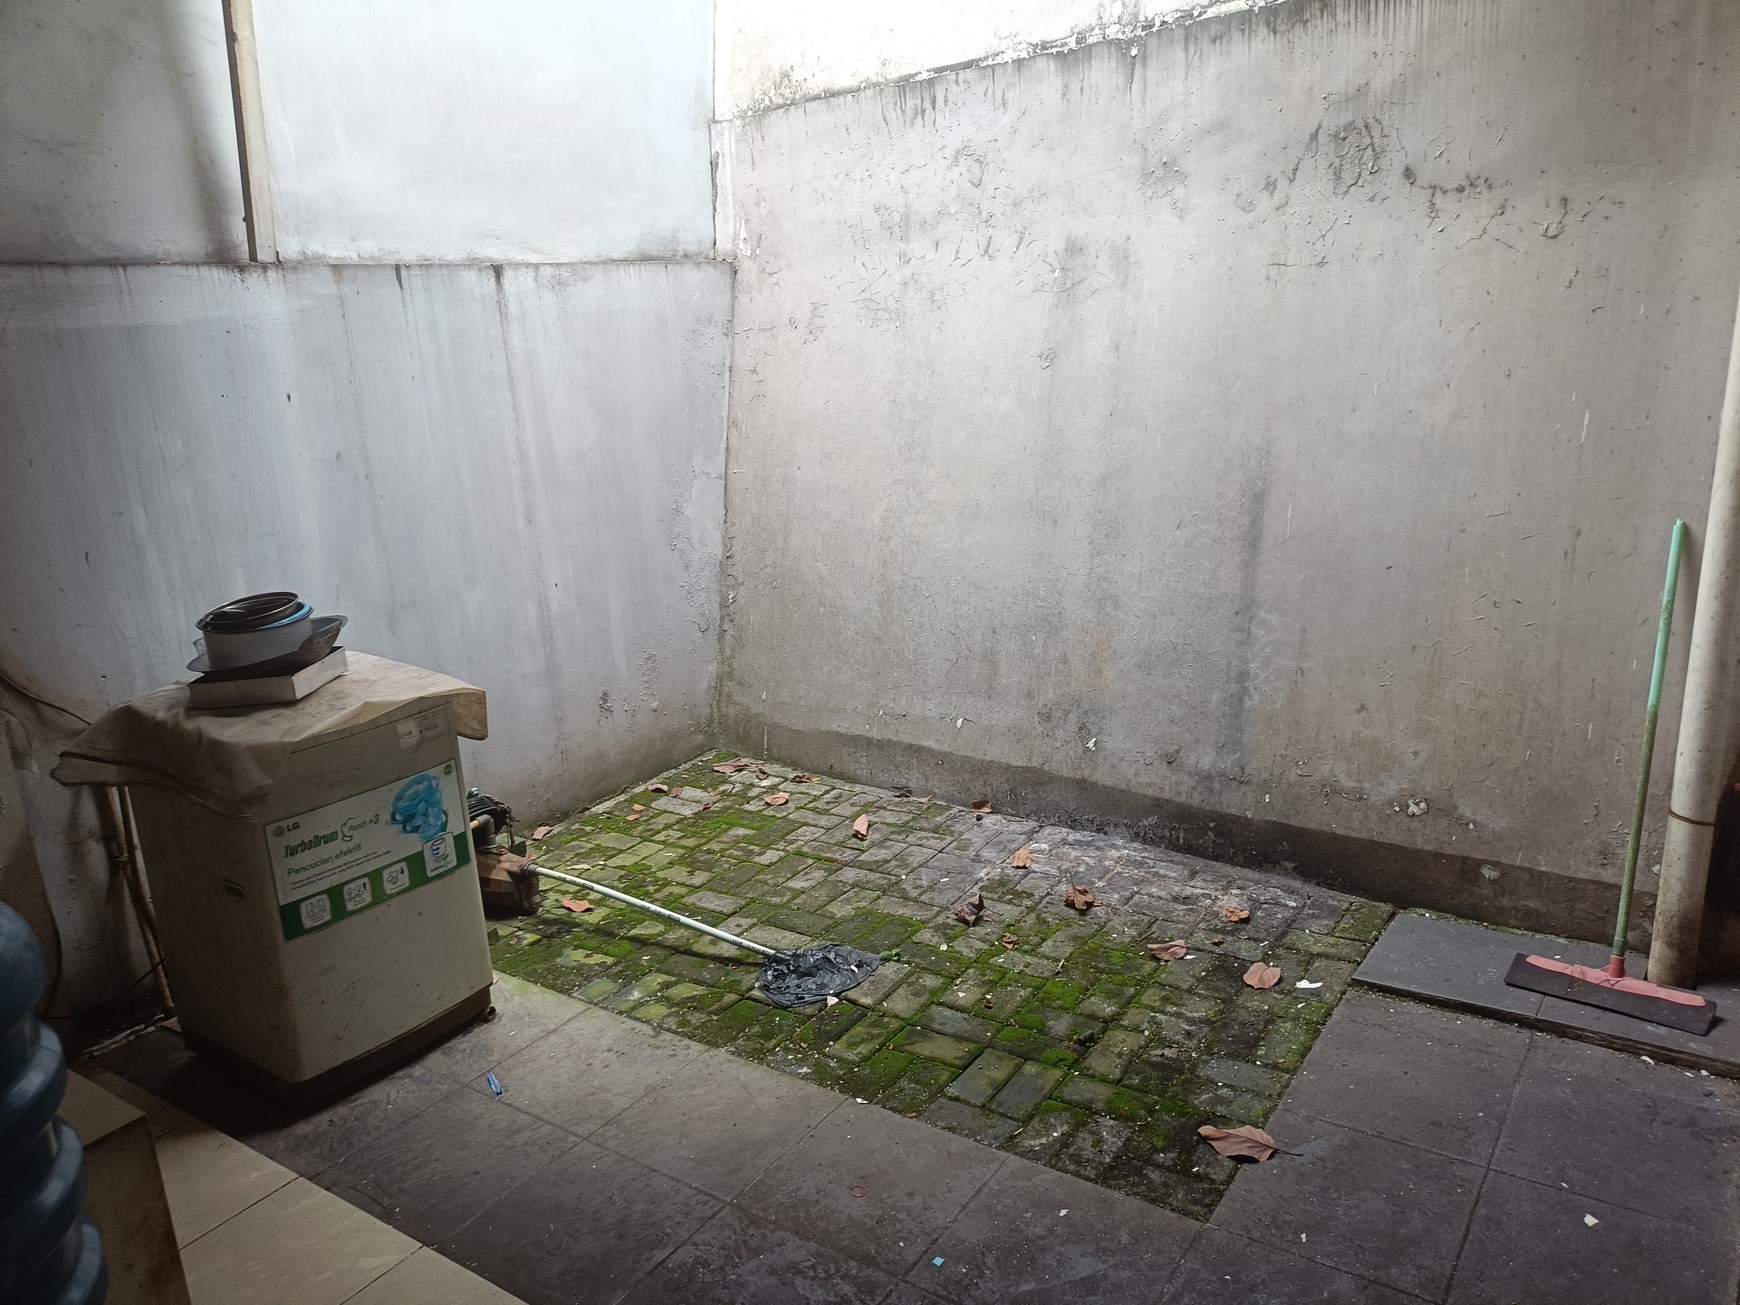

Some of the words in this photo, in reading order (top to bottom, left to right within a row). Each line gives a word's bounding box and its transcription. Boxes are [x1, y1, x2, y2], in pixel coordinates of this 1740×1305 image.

[287, 822, 300, 832] LG
[284, 830, 338, 858] TurboDrum
[287, 856, 333, 877] Pencucian
[334, 842, 362, 860] efektif
